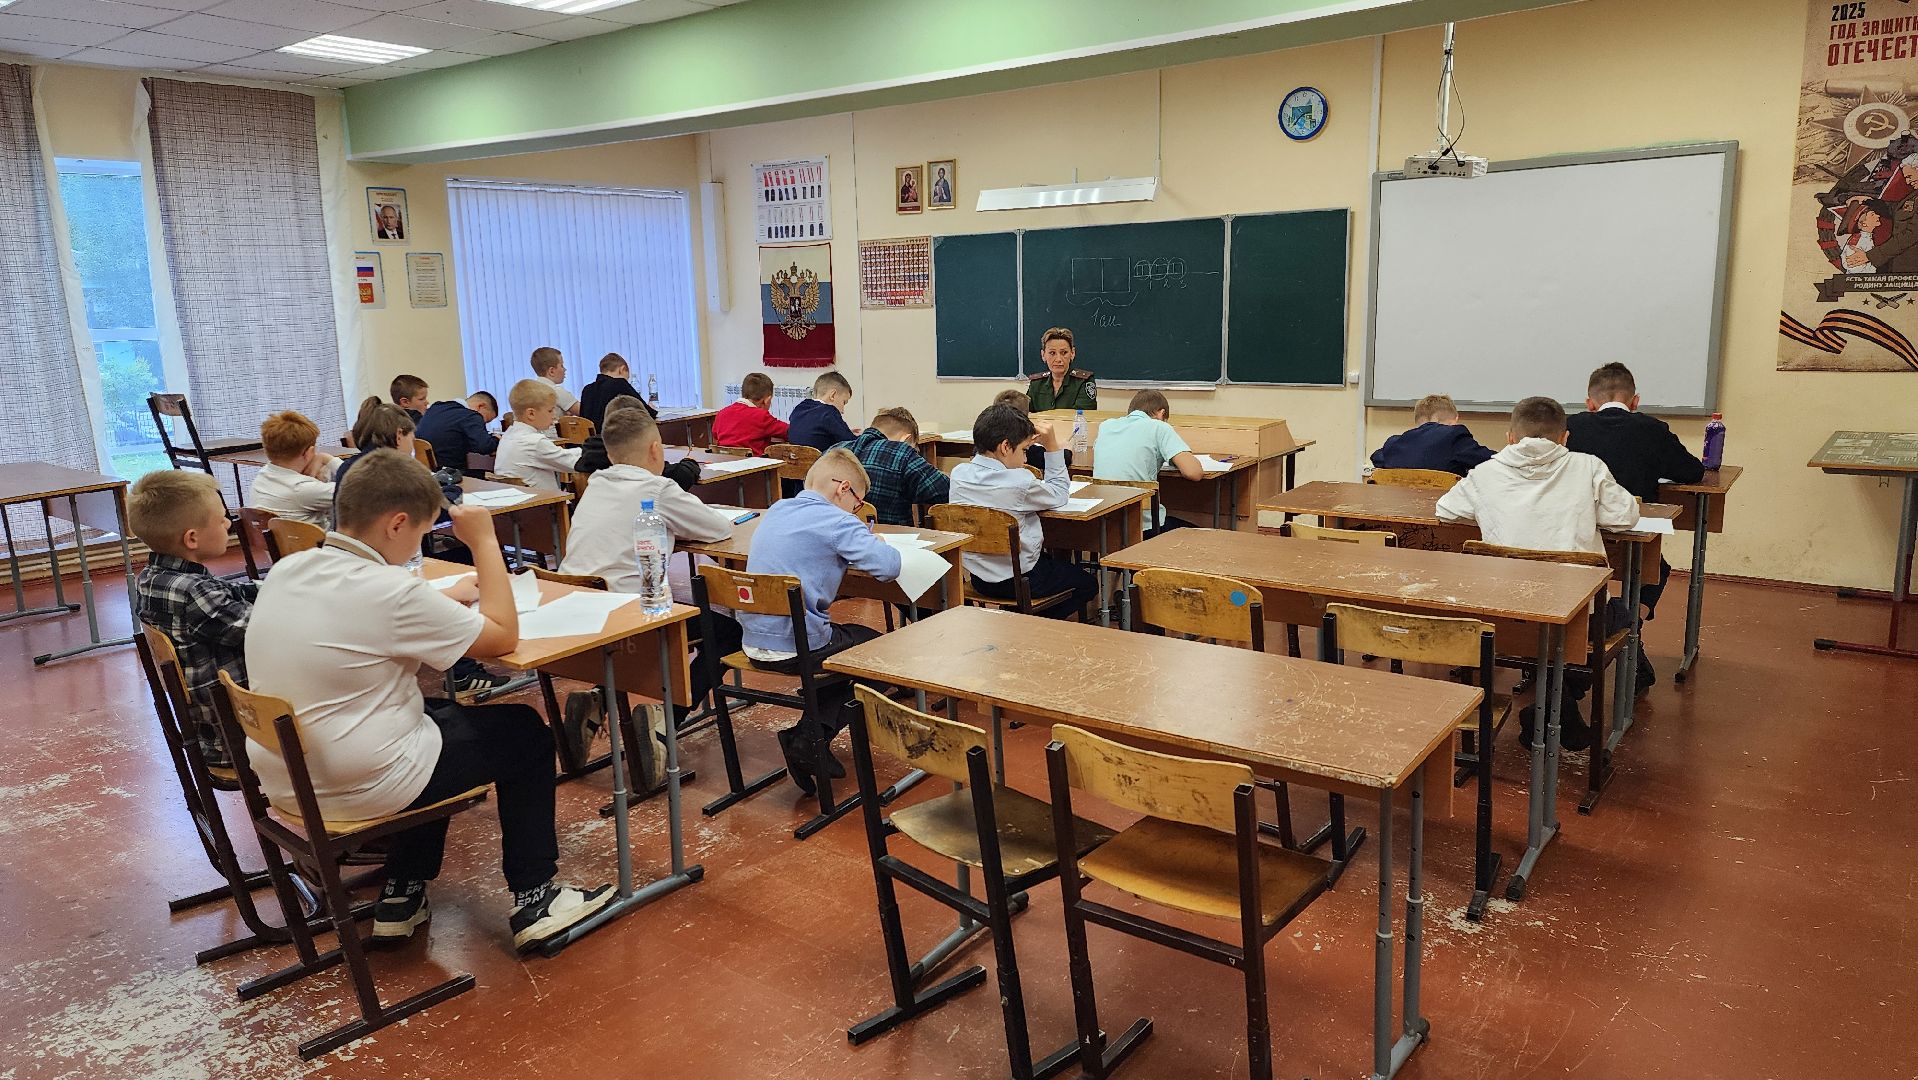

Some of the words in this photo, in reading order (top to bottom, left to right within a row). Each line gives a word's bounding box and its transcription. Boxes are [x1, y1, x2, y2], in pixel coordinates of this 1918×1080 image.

[1831, 1, 1866, 21] 2025
[1829, 22, 1857, 40] ГОД
[1827, 34, 1918, 67] ОТЕЧЕСТ
[1853, 282, 1883, 290] РОДИНУ
